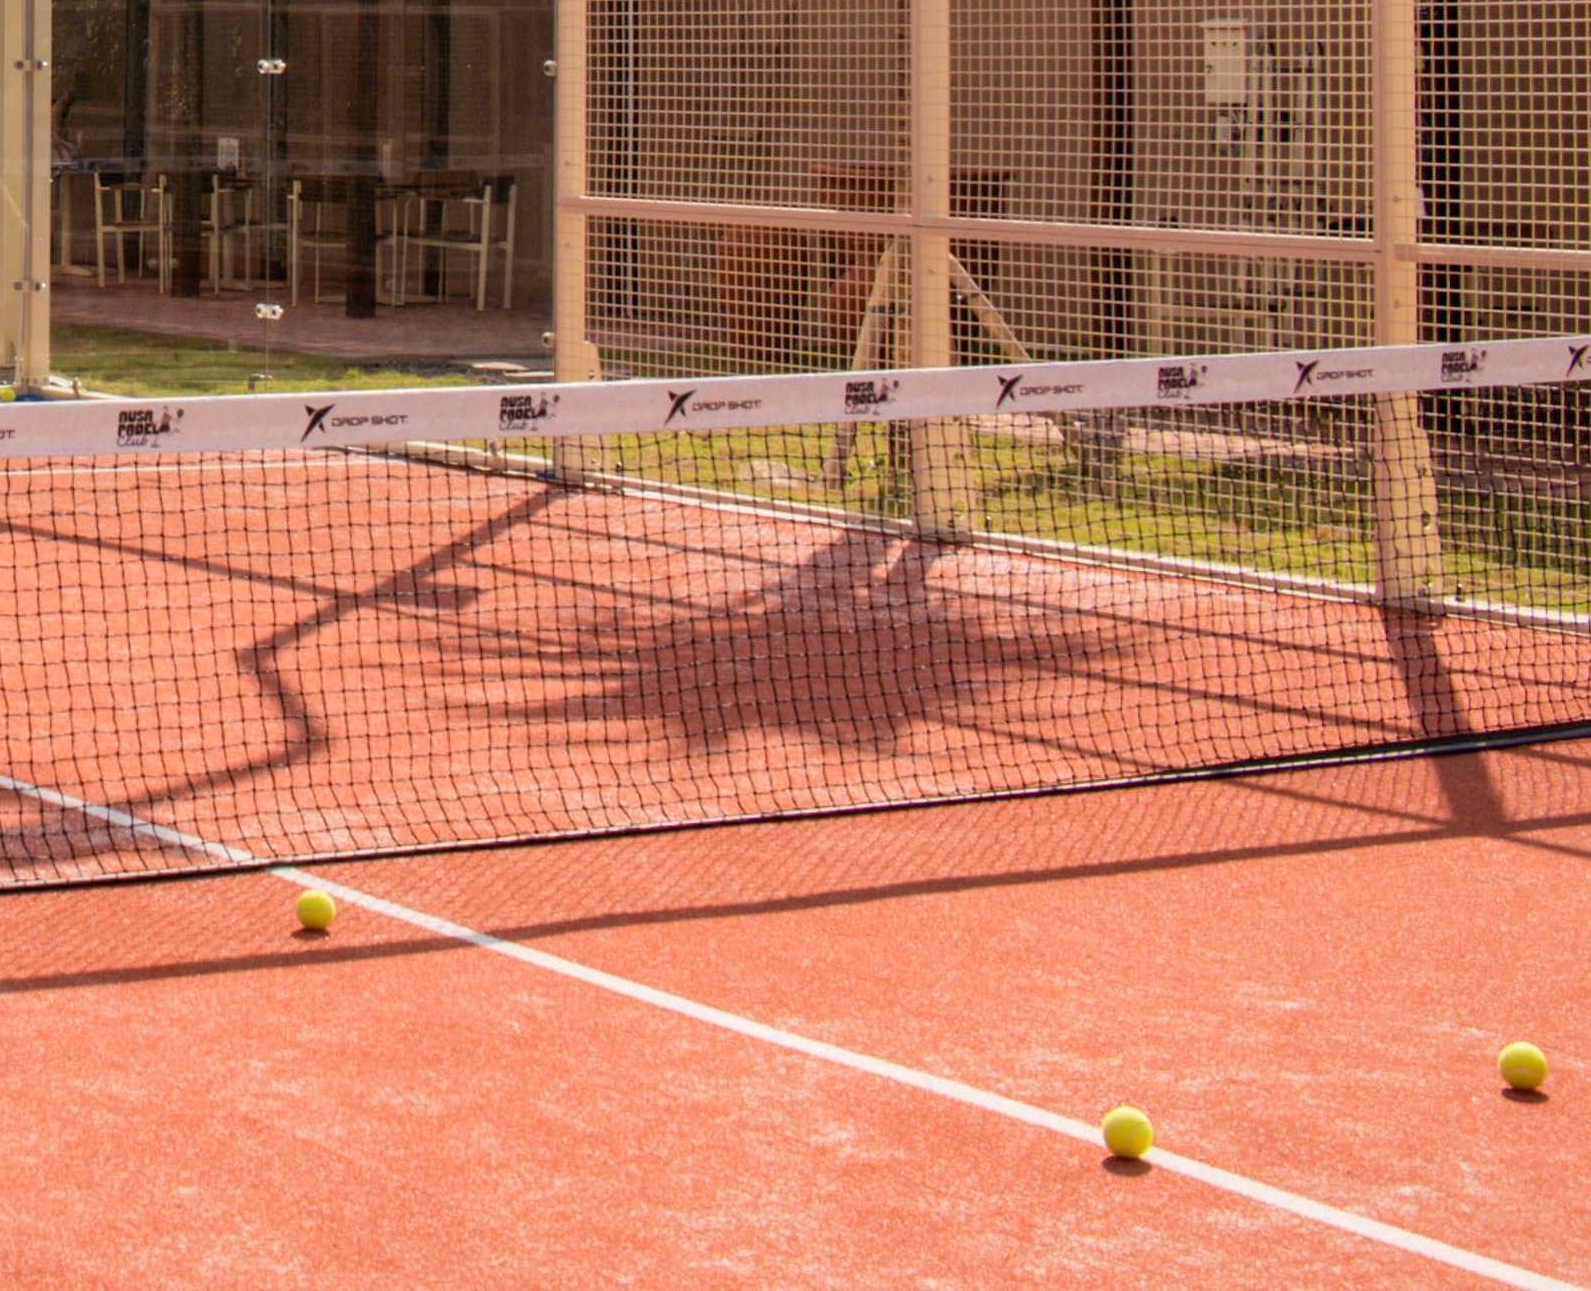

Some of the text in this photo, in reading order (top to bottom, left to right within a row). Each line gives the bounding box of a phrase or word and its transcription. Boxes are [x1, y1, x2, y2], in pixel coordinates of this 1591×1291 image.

[119, 410, 153, 422] NUSA
[331, 415, 408, 427] DROP SHOT
[118, 423, 160, 436] PADEL
